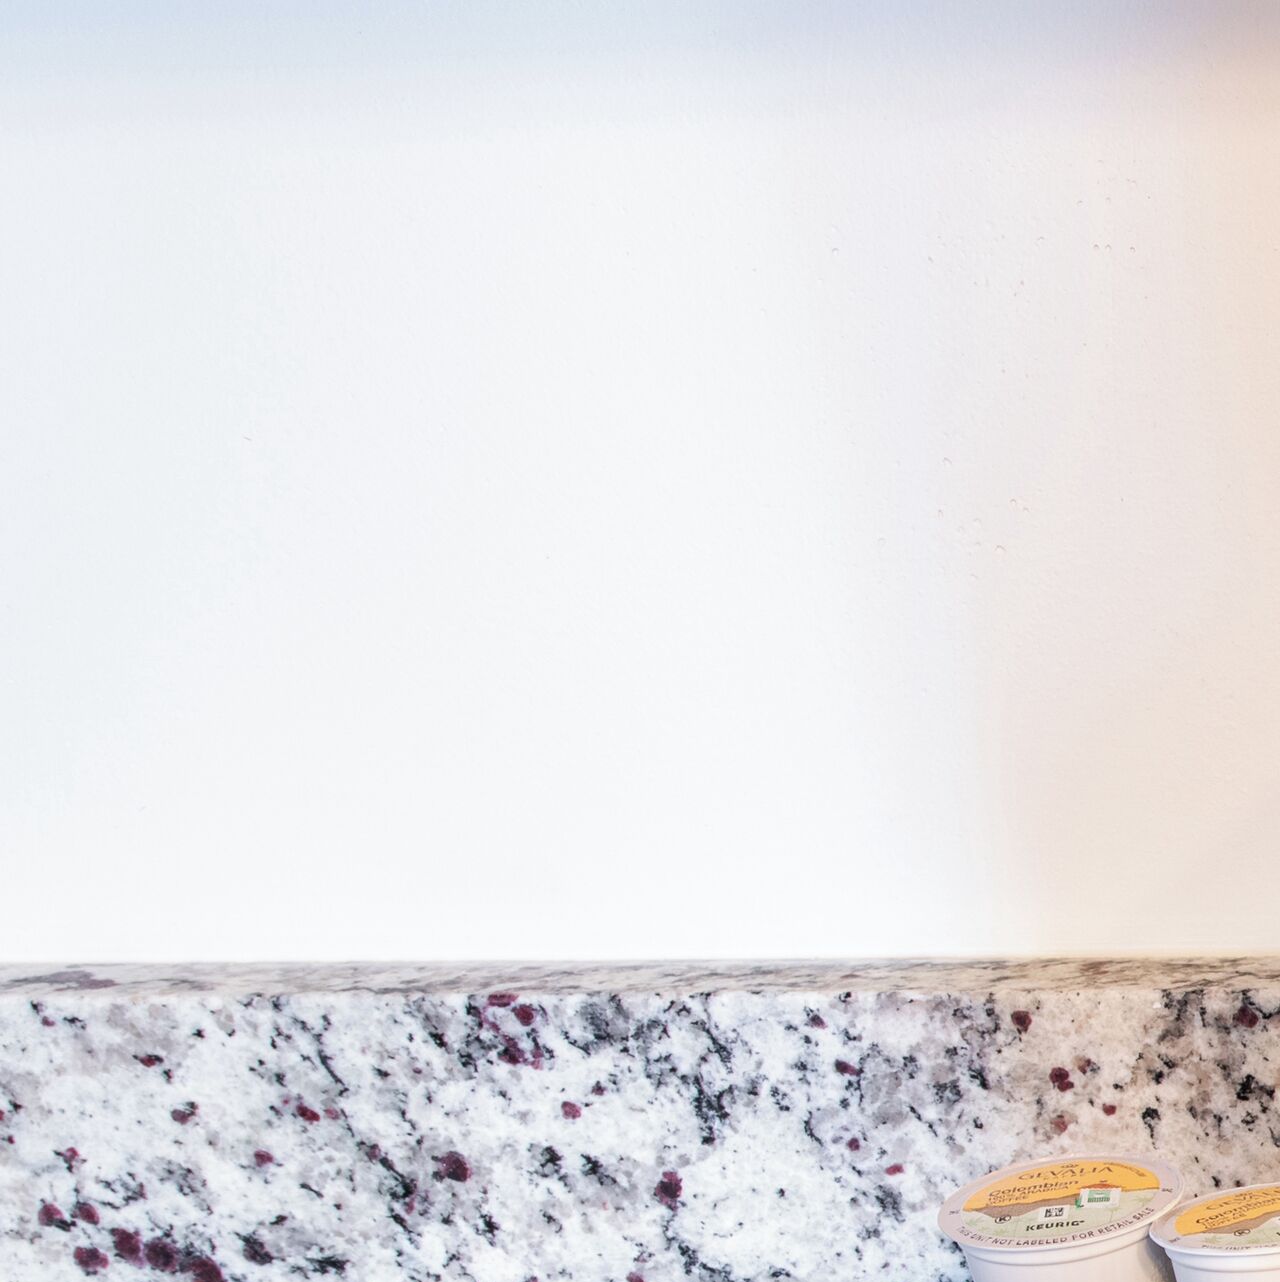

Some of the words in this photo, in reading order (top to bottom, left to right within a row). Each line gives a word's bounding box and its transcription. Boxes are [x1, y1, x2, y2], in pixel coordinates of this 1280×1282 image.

[988, 1179, 1080, 1198] Colombian
[992, 1237, 1014, 1246] NOT
[1016, 1236, 1069, 1247] LABELED
[1072, 1230, 1095, 1242] FOR
[1098, 1219, 1135, 1236] RETAIL
[1026, 1220, 1081, 1232] KEURIG
